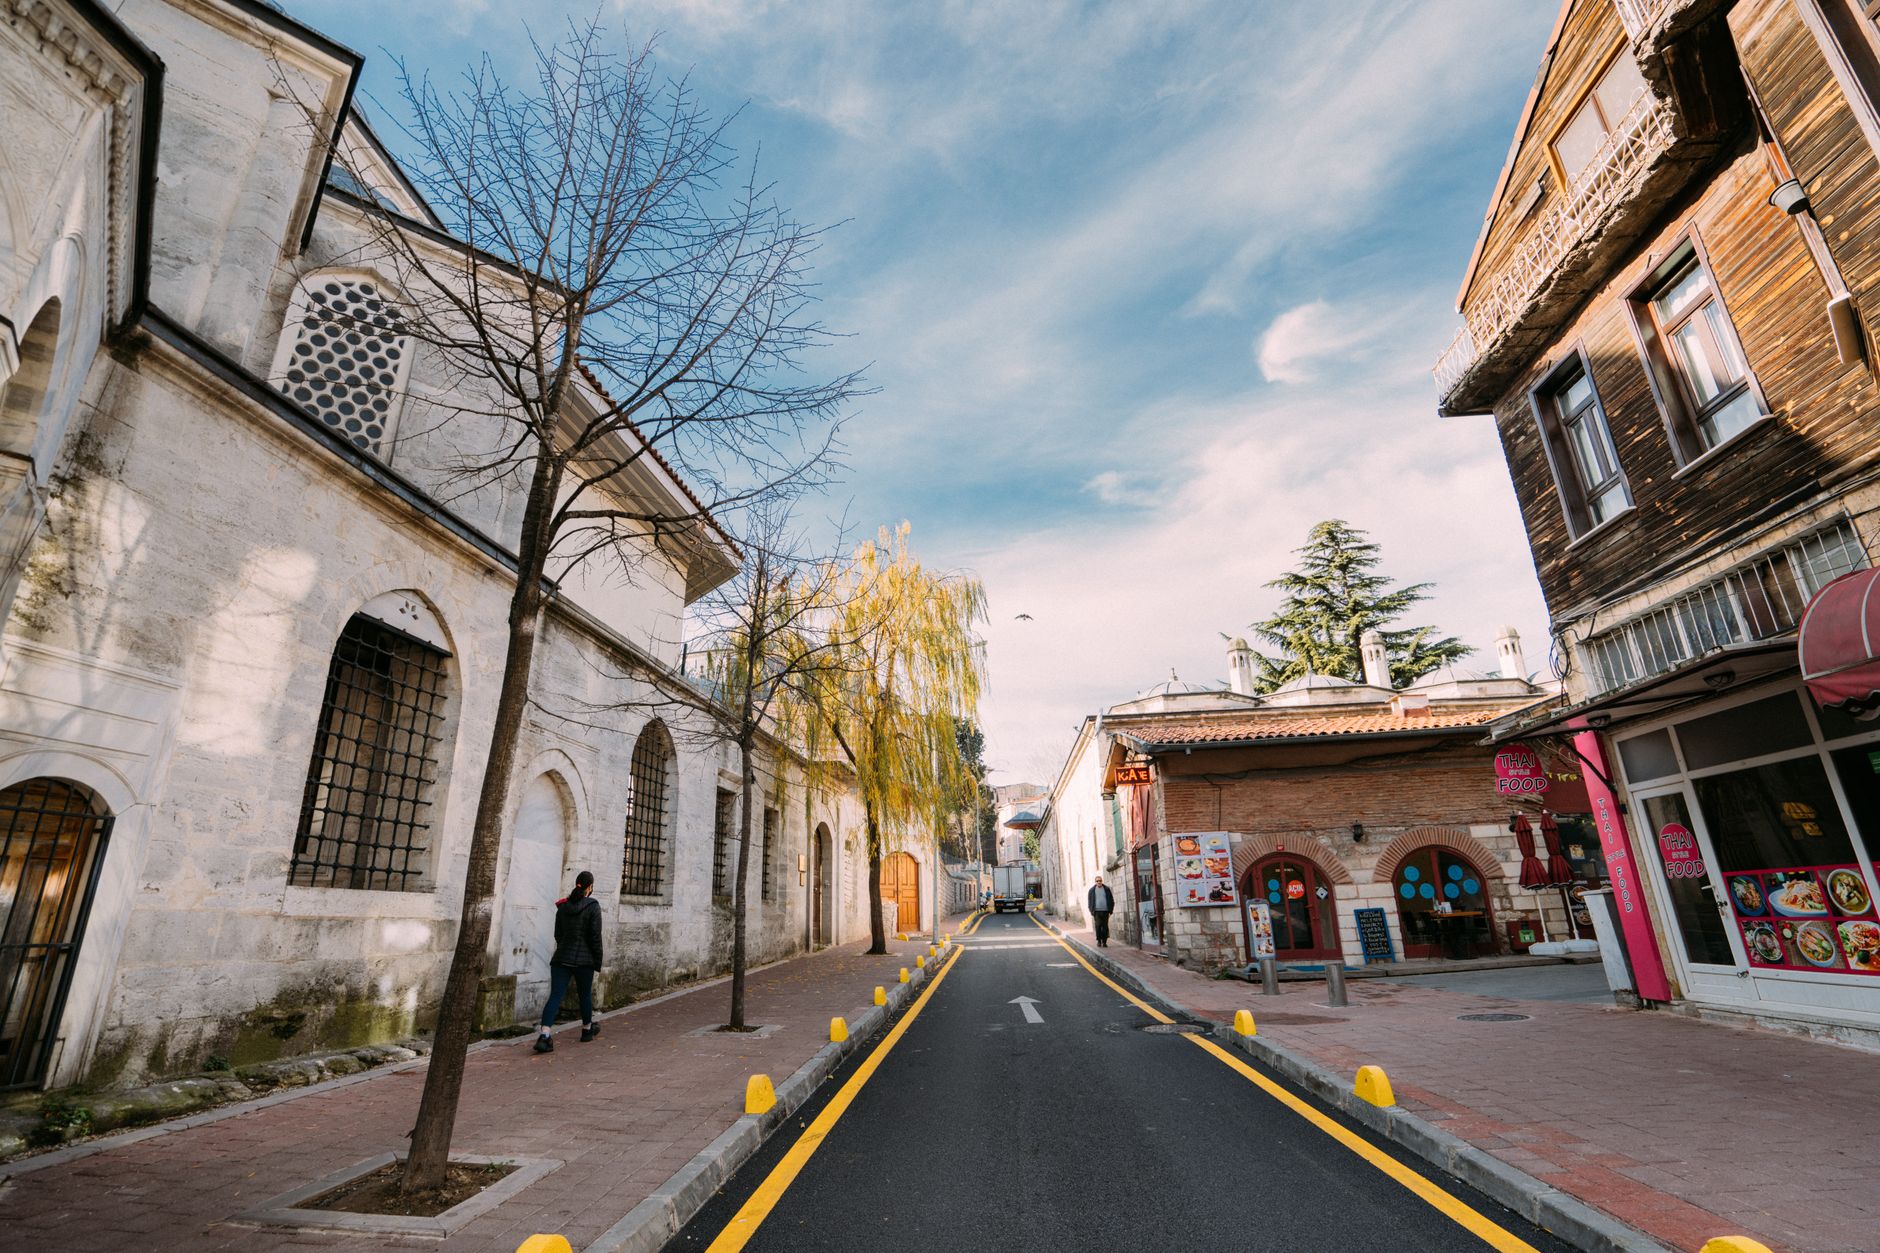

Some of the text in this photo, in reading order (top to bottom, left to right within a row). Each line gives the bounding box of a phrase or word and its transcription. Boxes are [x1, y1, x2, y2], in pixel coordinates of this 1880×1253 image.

[1498, 752, 1535, 768] THAI
[1498, 777, 1547, 792] FOOD
[1596, 797, 1614, 844] THAI
[1661, 832, 1692, 850] THAI
[1665, 858, 1706, 879] FOOD
[1615, 866, 1633, 913] FOOD
